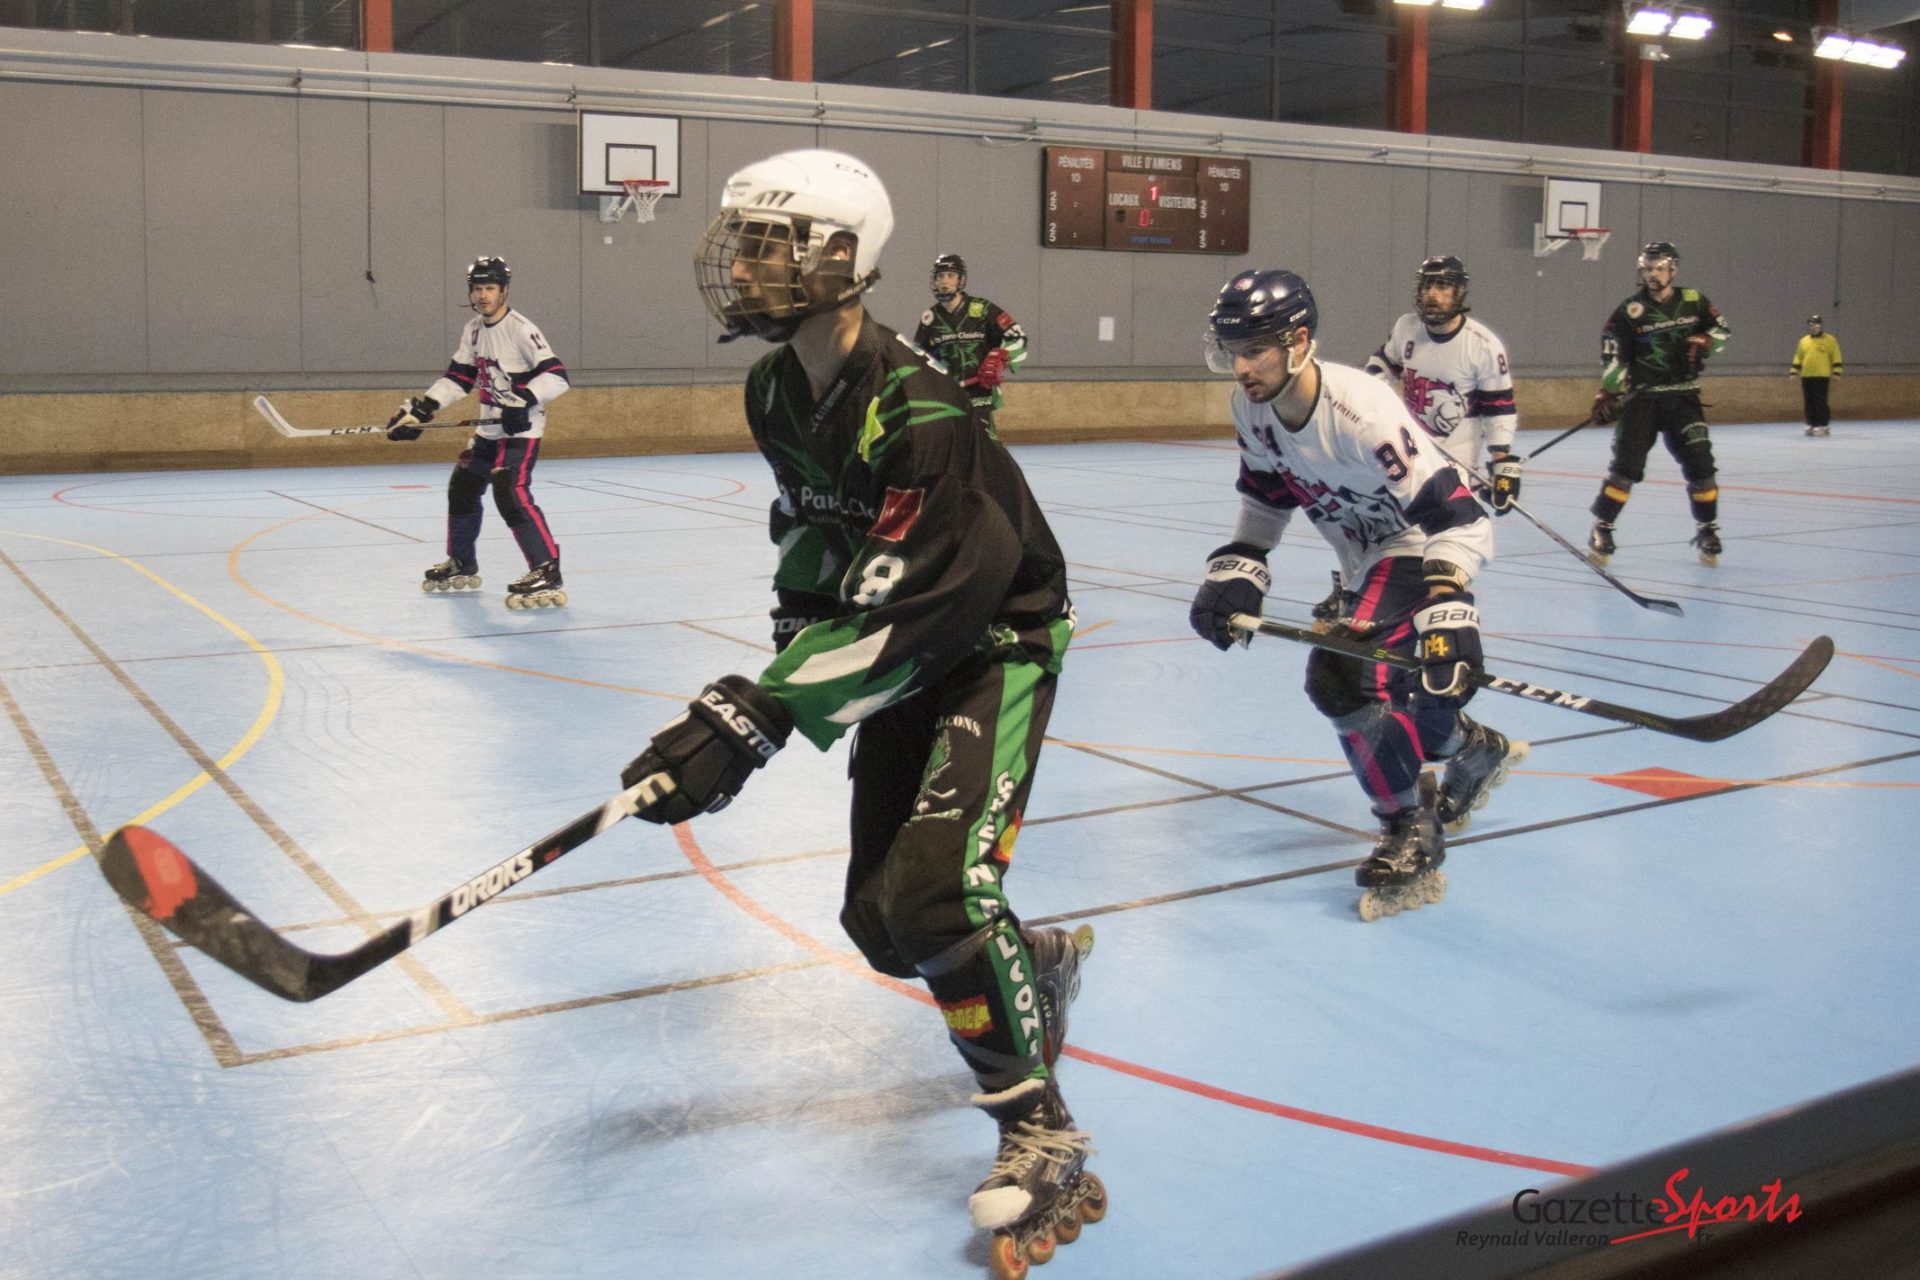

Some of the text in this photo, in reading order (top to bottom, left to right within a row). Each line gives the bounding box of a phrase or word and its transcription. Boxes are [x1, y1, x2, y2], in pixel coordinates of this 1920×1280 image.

[1121, 155, 1143, 168] VILLE
[1108, 193, 1140, 206] LOCAUX
[1150, 186, 1159, 201] 1
[1159, 196, 1197, 210] VISITEURS
[1404, 340, 1415, 360] 8
[1497, 353, 1508, 375] 8
[330, 426, 373, 436] CCM
[1374, 425, 1419, 483] 94
[853, 554, 905, 606] 8
[1488, 676, 1592, 711] CCM
